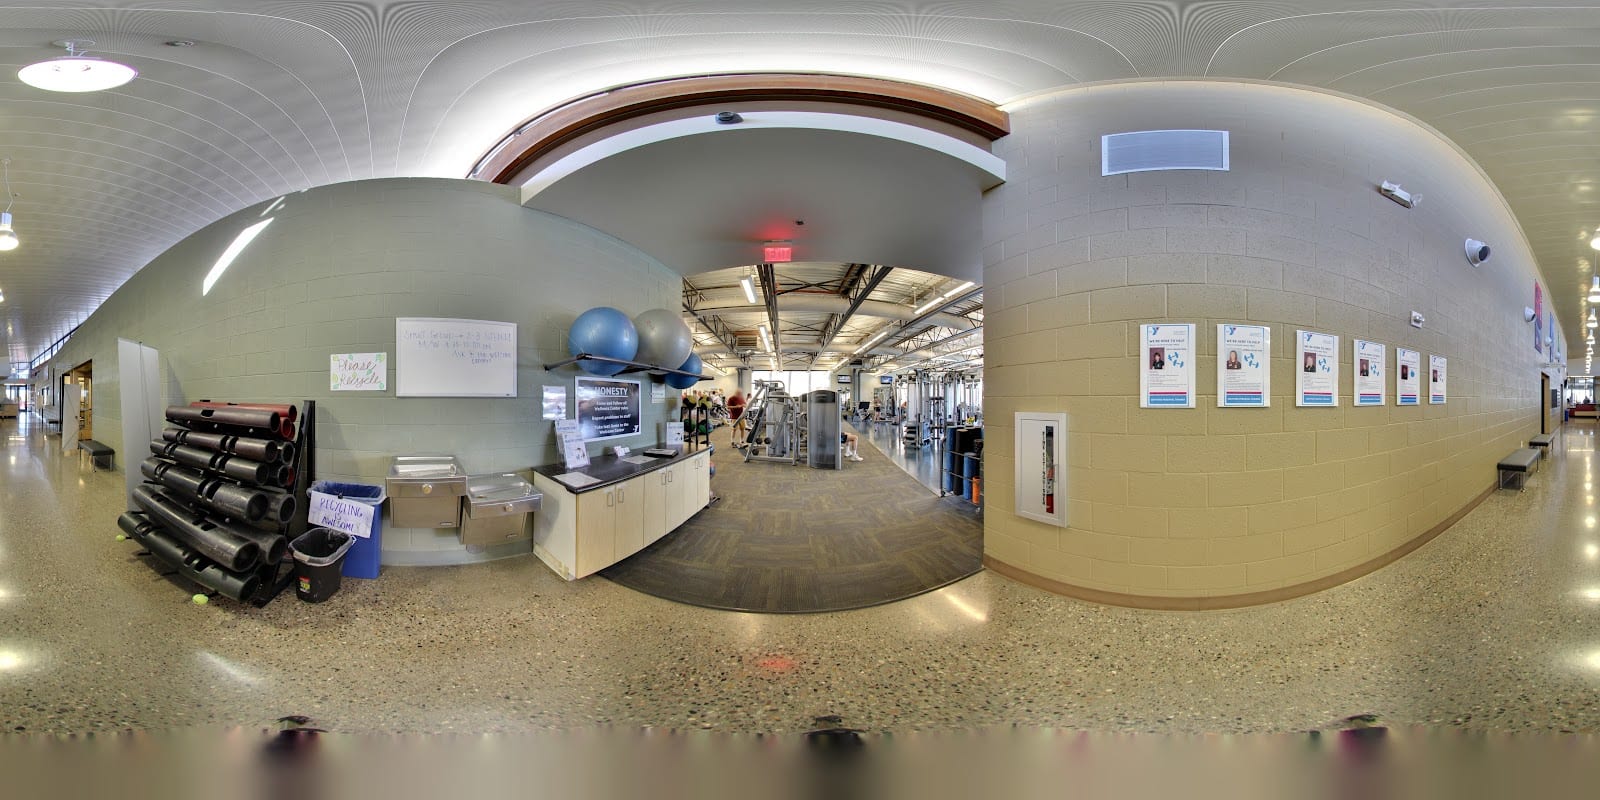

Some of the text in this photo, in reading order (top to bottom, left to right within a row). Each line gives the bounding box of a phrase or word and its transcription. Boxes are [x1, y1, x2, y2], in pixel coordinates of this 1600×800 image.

[768, 248, 789, 260] EXIT
[338, 359, 376, 371] Please
[340, 372, 381, 389] Recycle
[594, 386, 628, 396] HONESTY
[320, 497, 363, 517] RECYCLING
